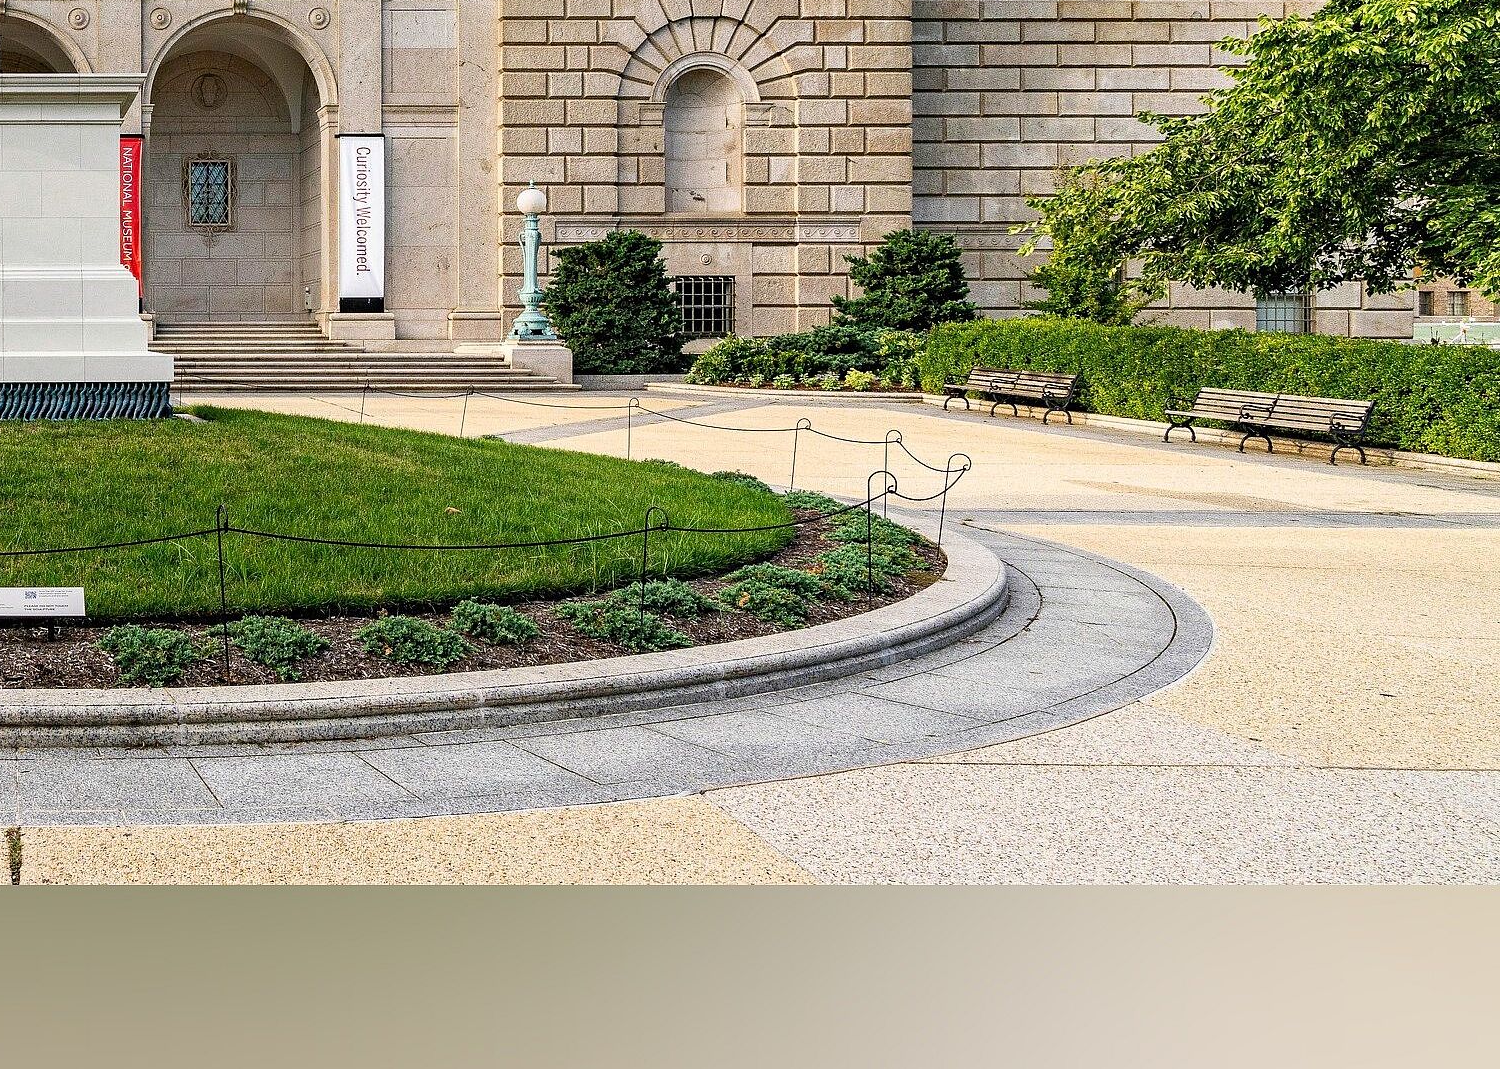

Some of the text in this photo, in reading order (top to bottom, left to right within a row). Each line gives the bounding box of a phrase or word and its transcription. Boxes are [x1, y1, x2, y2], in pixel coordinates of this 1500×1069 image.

[122, 147, 133, 206] NATIONAL
[122, 210, 133, 261] MUSEUM
[352, 146, 371, 276] Curiosity Welcomed.
